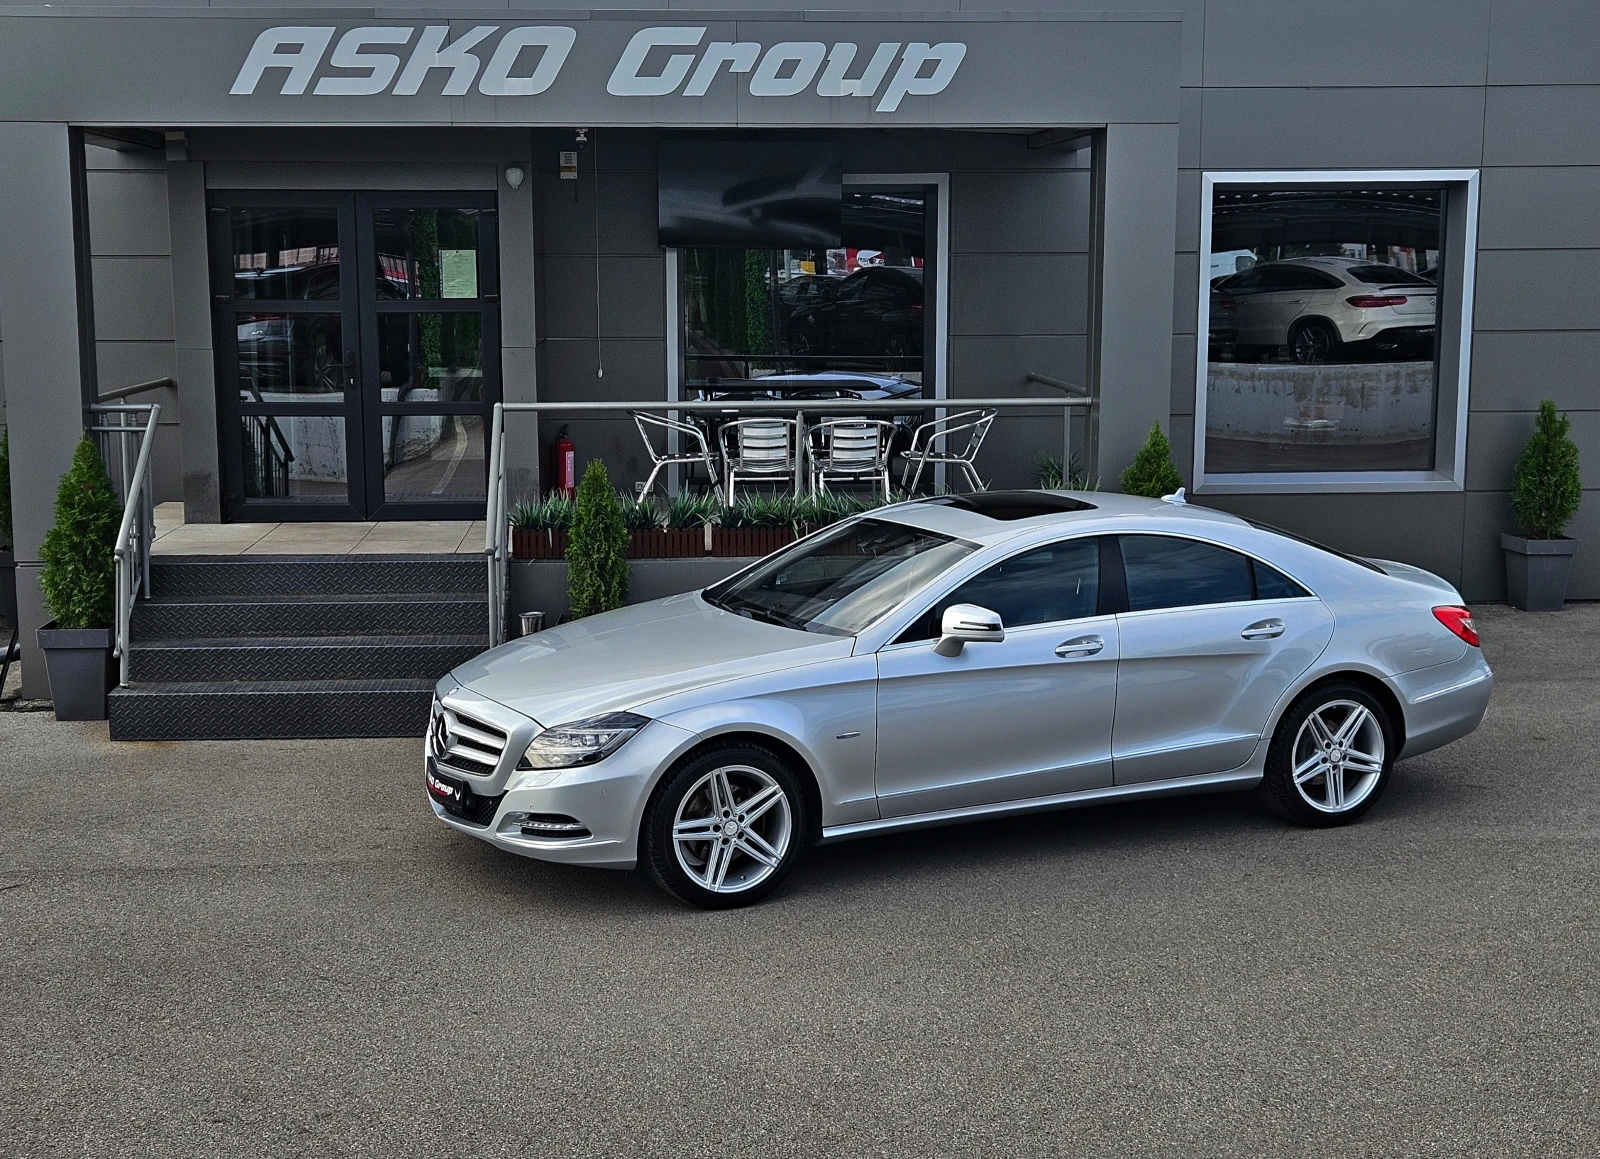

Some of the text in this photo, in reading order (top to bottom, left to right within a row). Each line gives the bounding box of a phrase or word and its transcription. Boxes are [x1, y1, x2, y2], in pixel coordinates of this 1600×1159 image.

[229, 25, 967, 112] ASKO Group
[434, 779, 454, 796] Group
